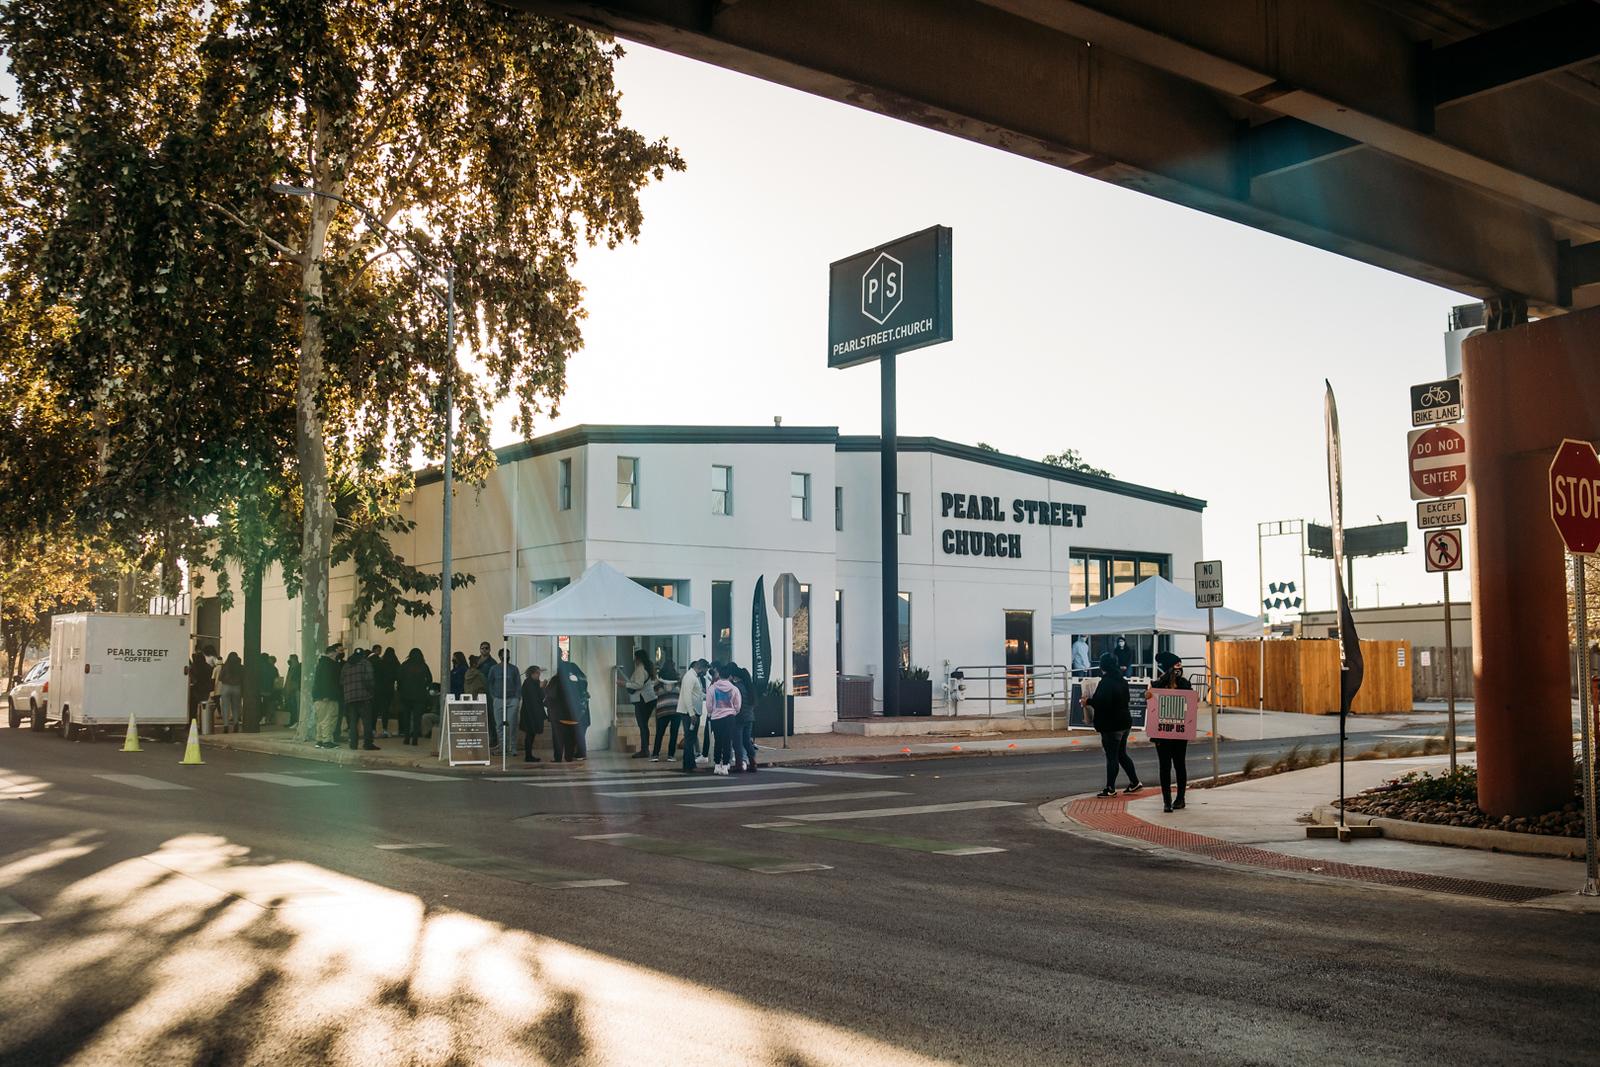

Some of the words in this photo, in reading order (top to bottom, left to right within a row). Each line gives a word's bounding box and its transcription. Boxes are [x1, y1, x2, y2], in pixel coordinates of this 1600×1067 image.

[833, 318, 933, 356] PEARLSTREET.CHURCH
[1415, 411, 1433, 423] BIKE
[1436, 406, 1458, 419] LANE
[1417, 443, 1431, 455] DO
[1438, 438, 1460, 452] NOT
[1422, 470, 1458, 485] ENTER
[941, 492, 1005, 521] PEARL
[1013, 499, 1086, 528] STREET
[1426, 502, 1456, 514] EXCEPT
[1422, 513, 1461, 526] BICYCLES
[942, 529, 1022, 558] CHURCH
[1203, 564, 1213, 575] NO
[1198, 580, 1220, 589] TRUCKS
[1197, 593, 1222, 603] ALLOWED
[107, 648, 135, 656] PEARL
[137, 649, 168, 657] STREET
[1158, 724, 1175, 732] STOP
[1175, 725, 1185, 733] US
